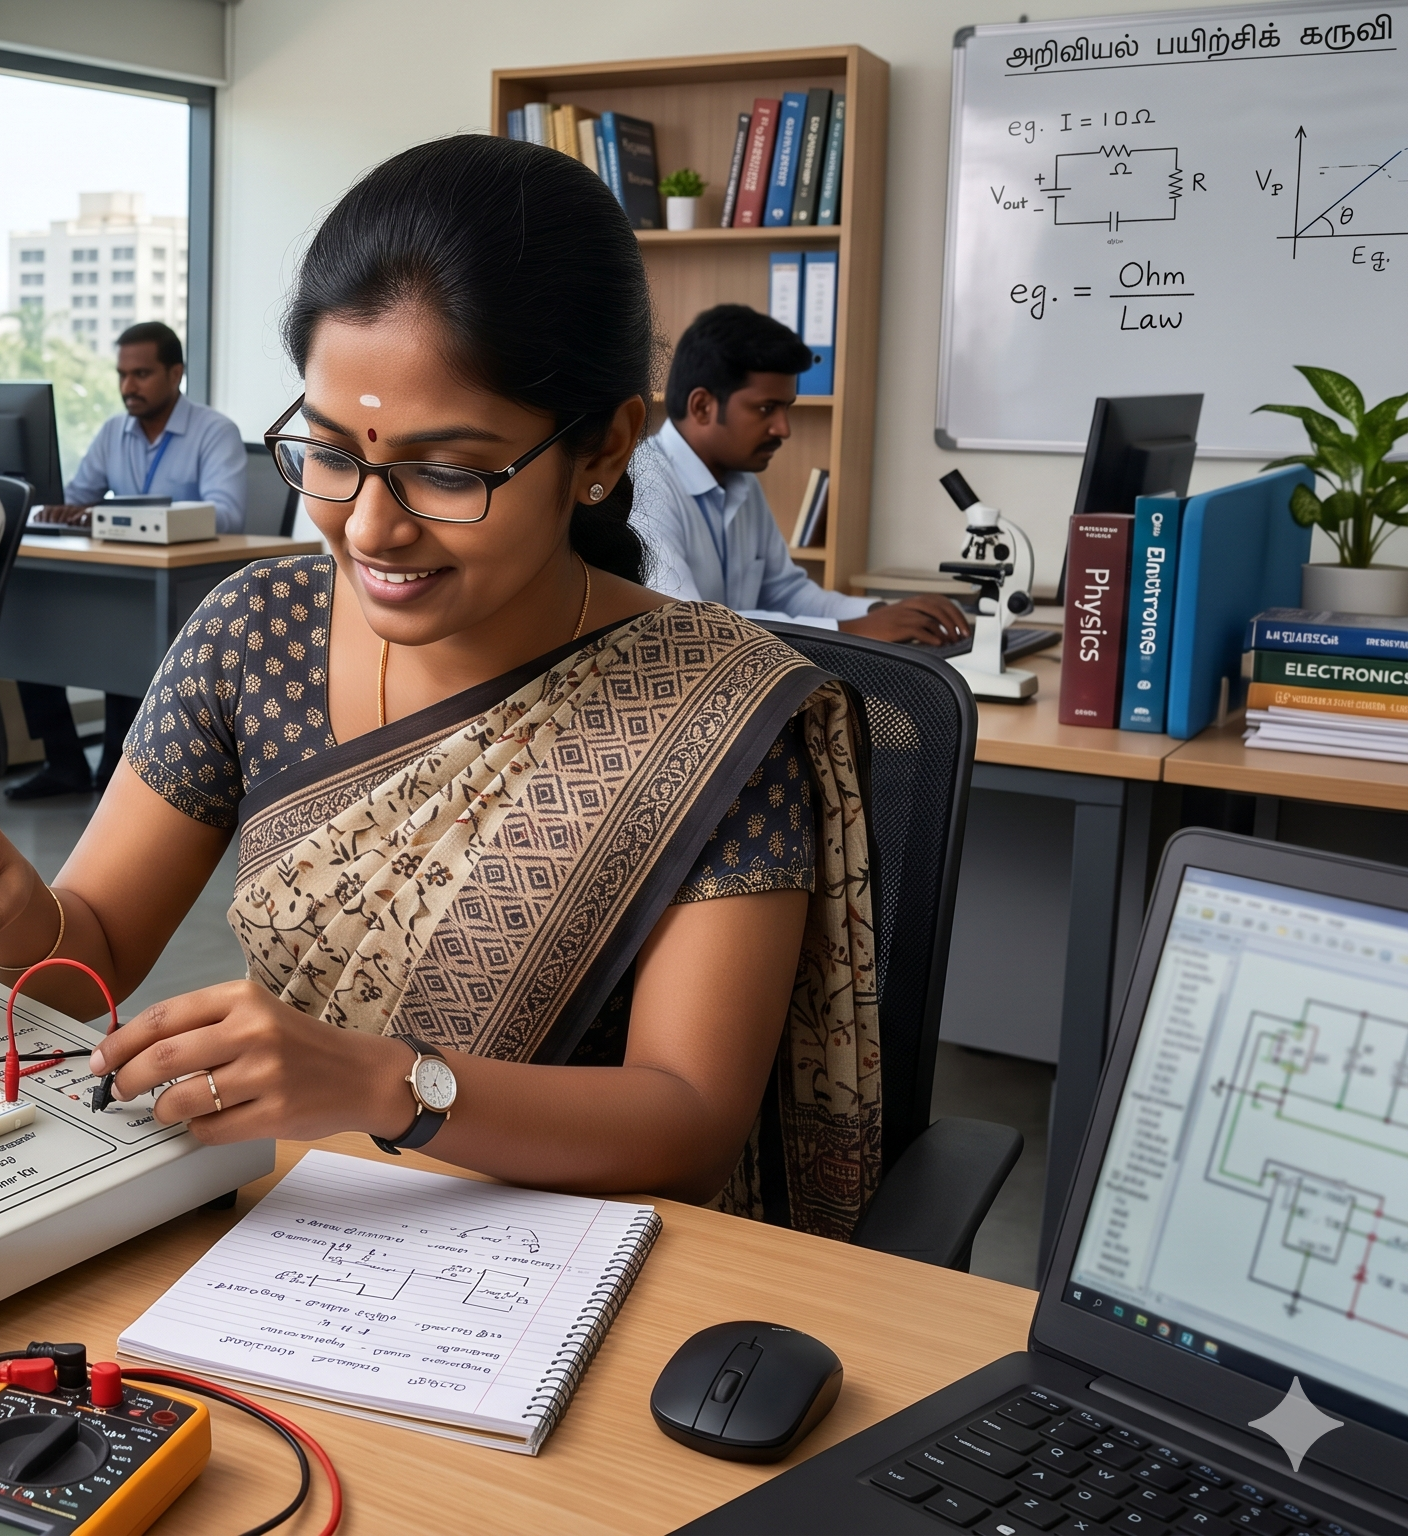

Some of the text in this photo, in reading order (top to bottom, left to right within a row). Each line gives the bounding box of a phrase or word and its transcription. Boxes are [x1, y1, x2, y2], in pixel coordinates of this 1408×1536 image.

[1005, 13, 1394, 72] அறிவியல் பயிற்சிக் கருவி
[1008, 120, 1044, 144] eg.
[1060, 113, 1072, 132] I
[1192, 173, 1207, 191] R
[1119, 261, 1185, 288] Ohm
[1010, 283, 1058, 320] eg.
[1120, 305, 1183, 331] Law
[1074, 568, 1110, 662] Physics
